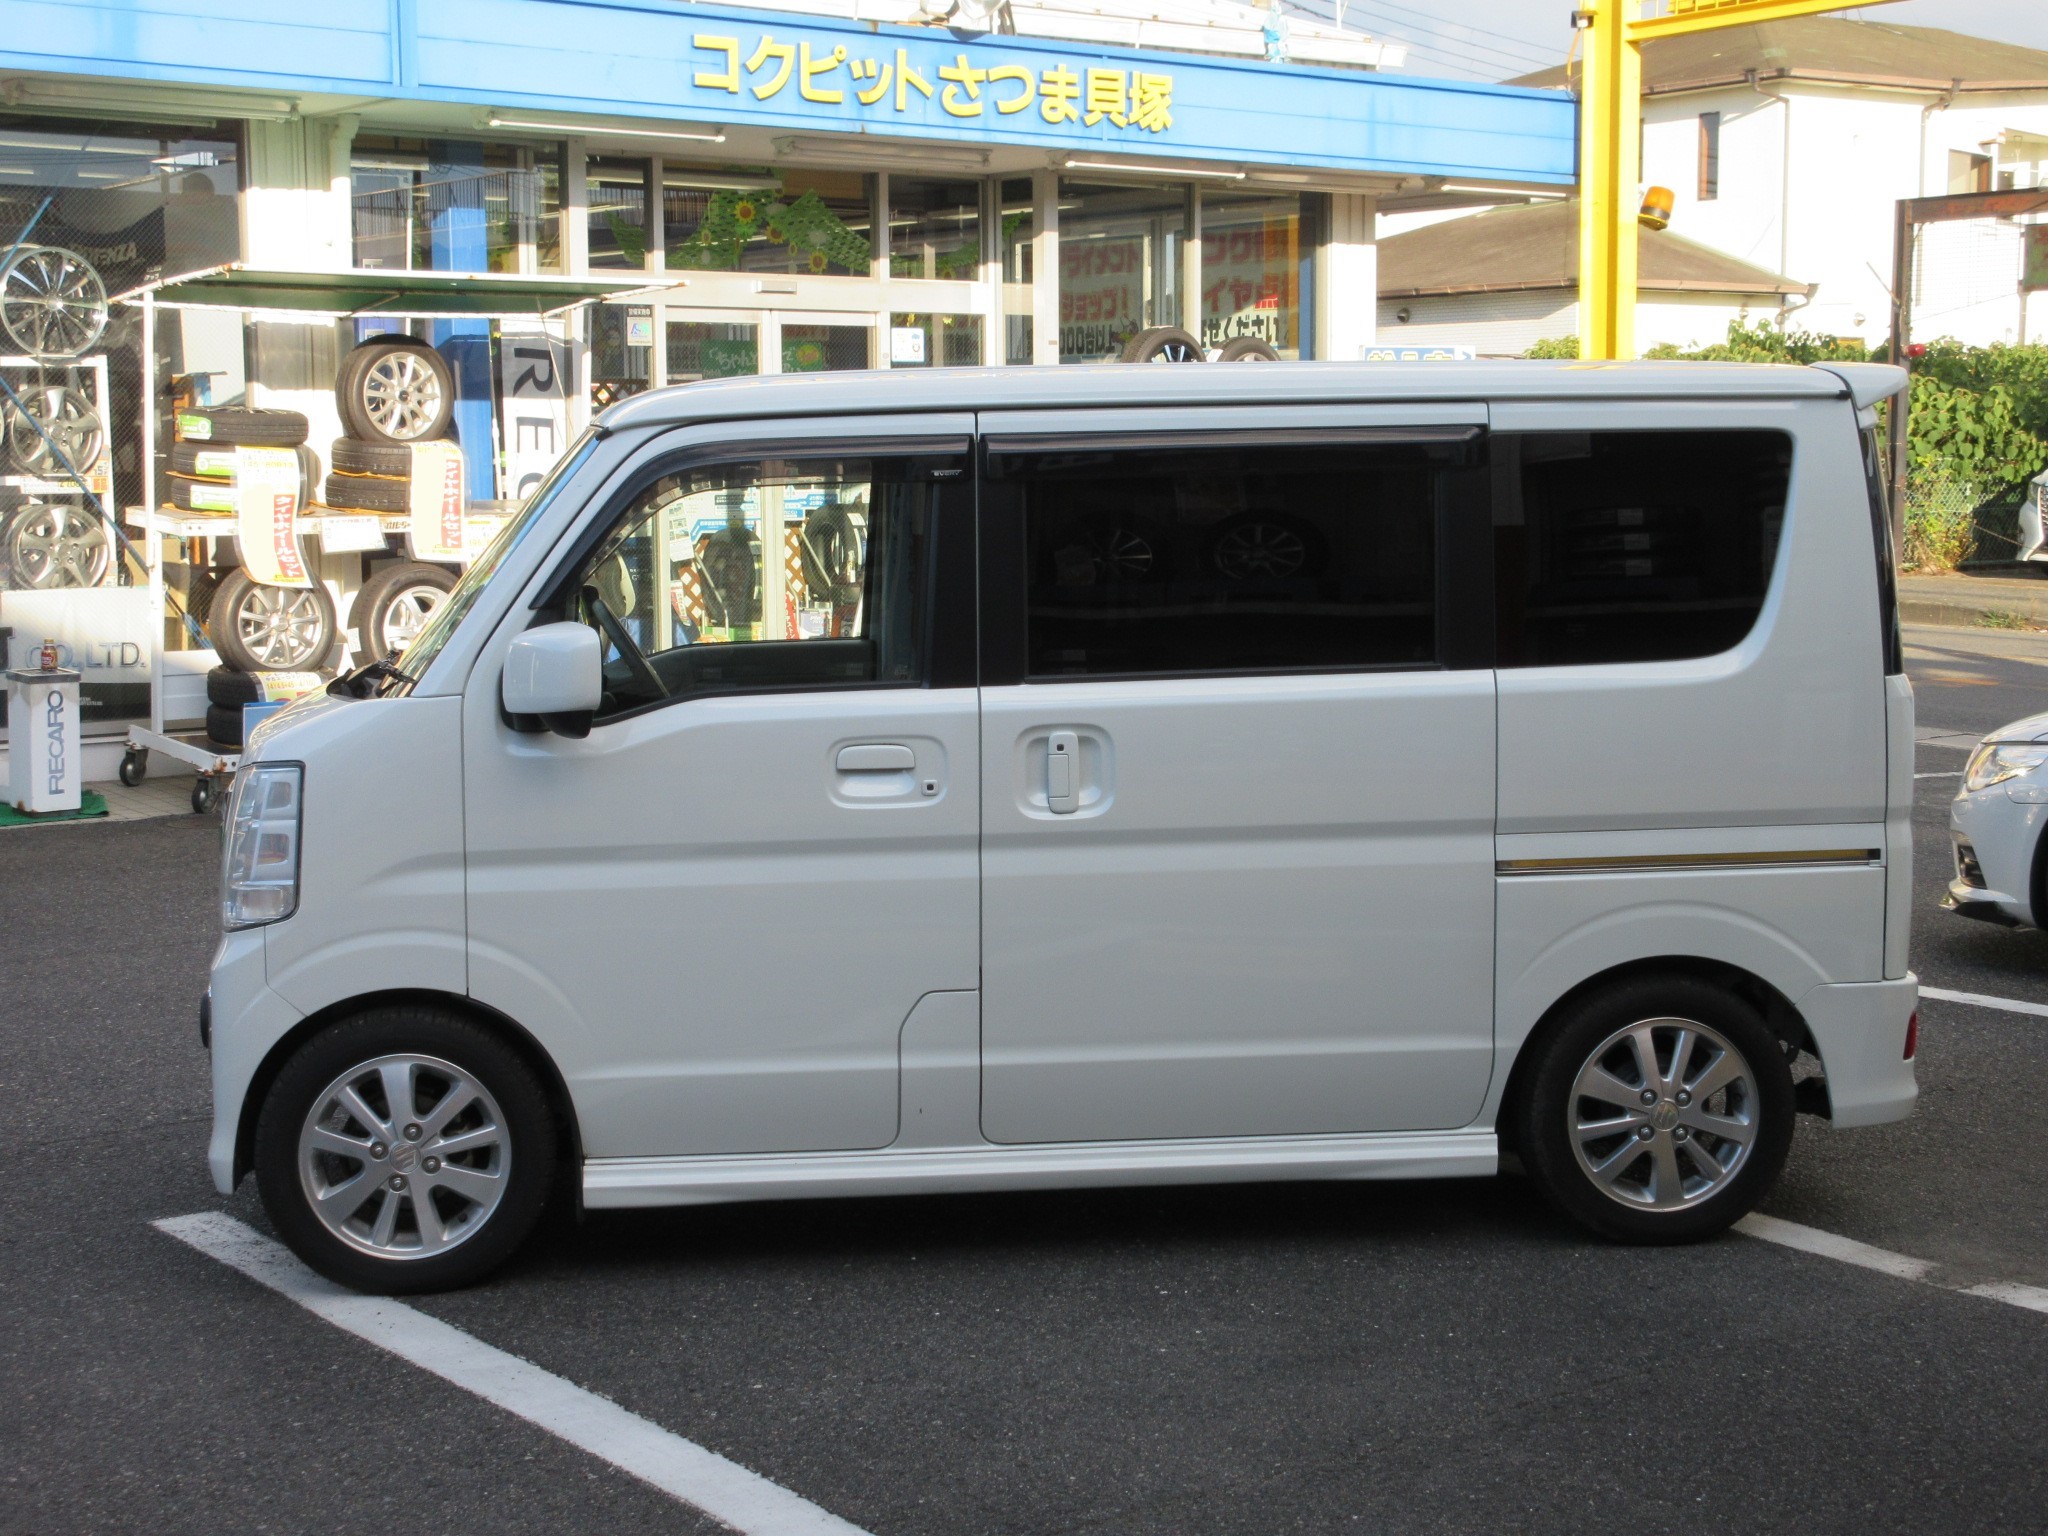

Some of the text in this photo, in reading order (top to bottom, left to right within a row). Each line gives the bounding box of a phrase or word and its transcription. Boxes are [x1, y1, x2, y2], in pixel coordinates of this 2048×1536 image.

[692, 34, 1174, 132] コクピットさつま貝塚
[274, 495, 301, 577] タイヤホイールセット
[441, 460, 461, 547] タイヤホイールセット
[47, 690, 66, 796] RECARO
